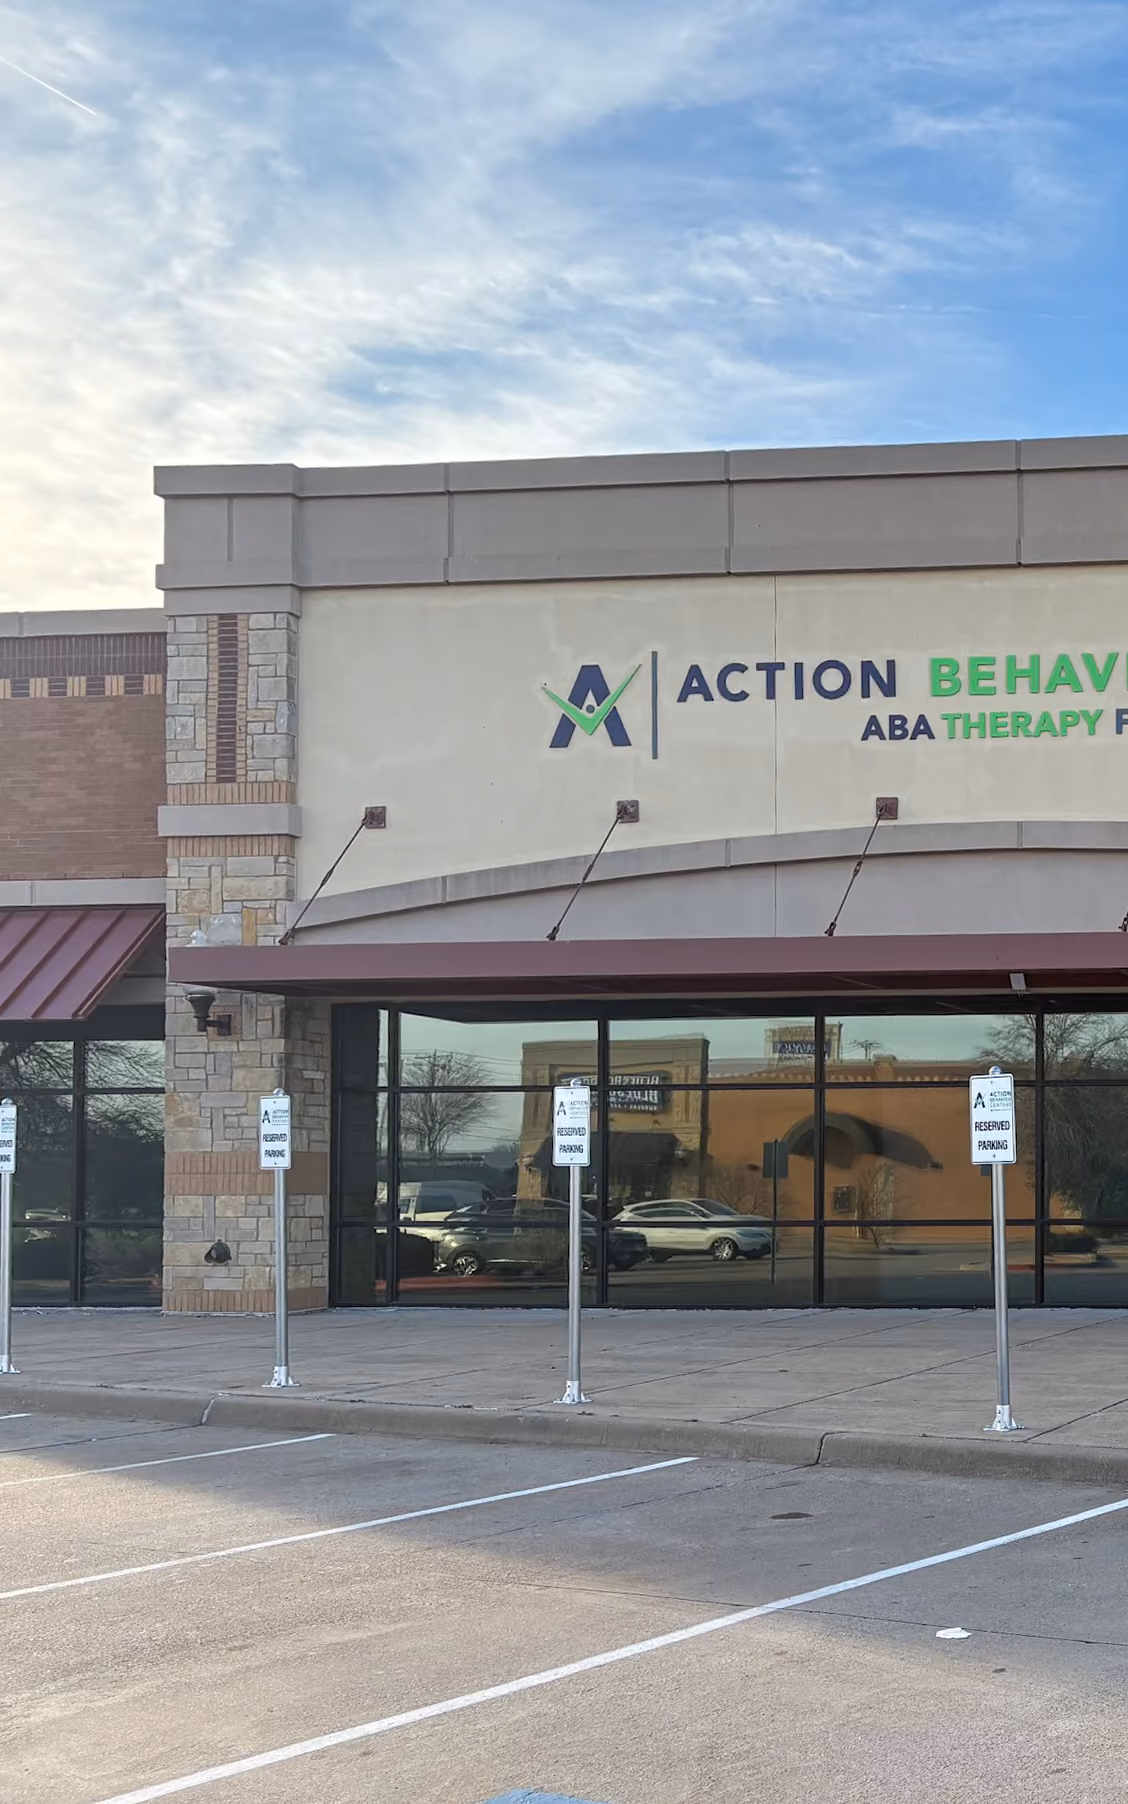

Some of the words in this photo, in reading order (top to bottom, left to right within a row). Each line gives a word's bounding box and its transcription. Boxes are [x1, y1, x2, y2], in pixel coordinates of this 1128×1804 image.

[677, 659, 896, 703] ACTION
[861, 714, 935, 741] ABA
[941, 709, 1103, 739] THERAPY
[974, 1120, 1010, 1131] RESERVED
[557, 1127, 586, 1136] RESERVED
[263, 1133, 287, 1142] RESERVED
[559, 1144, 584, 1153] PARKING
[978, 1140, 1008, 1150] PARKING
